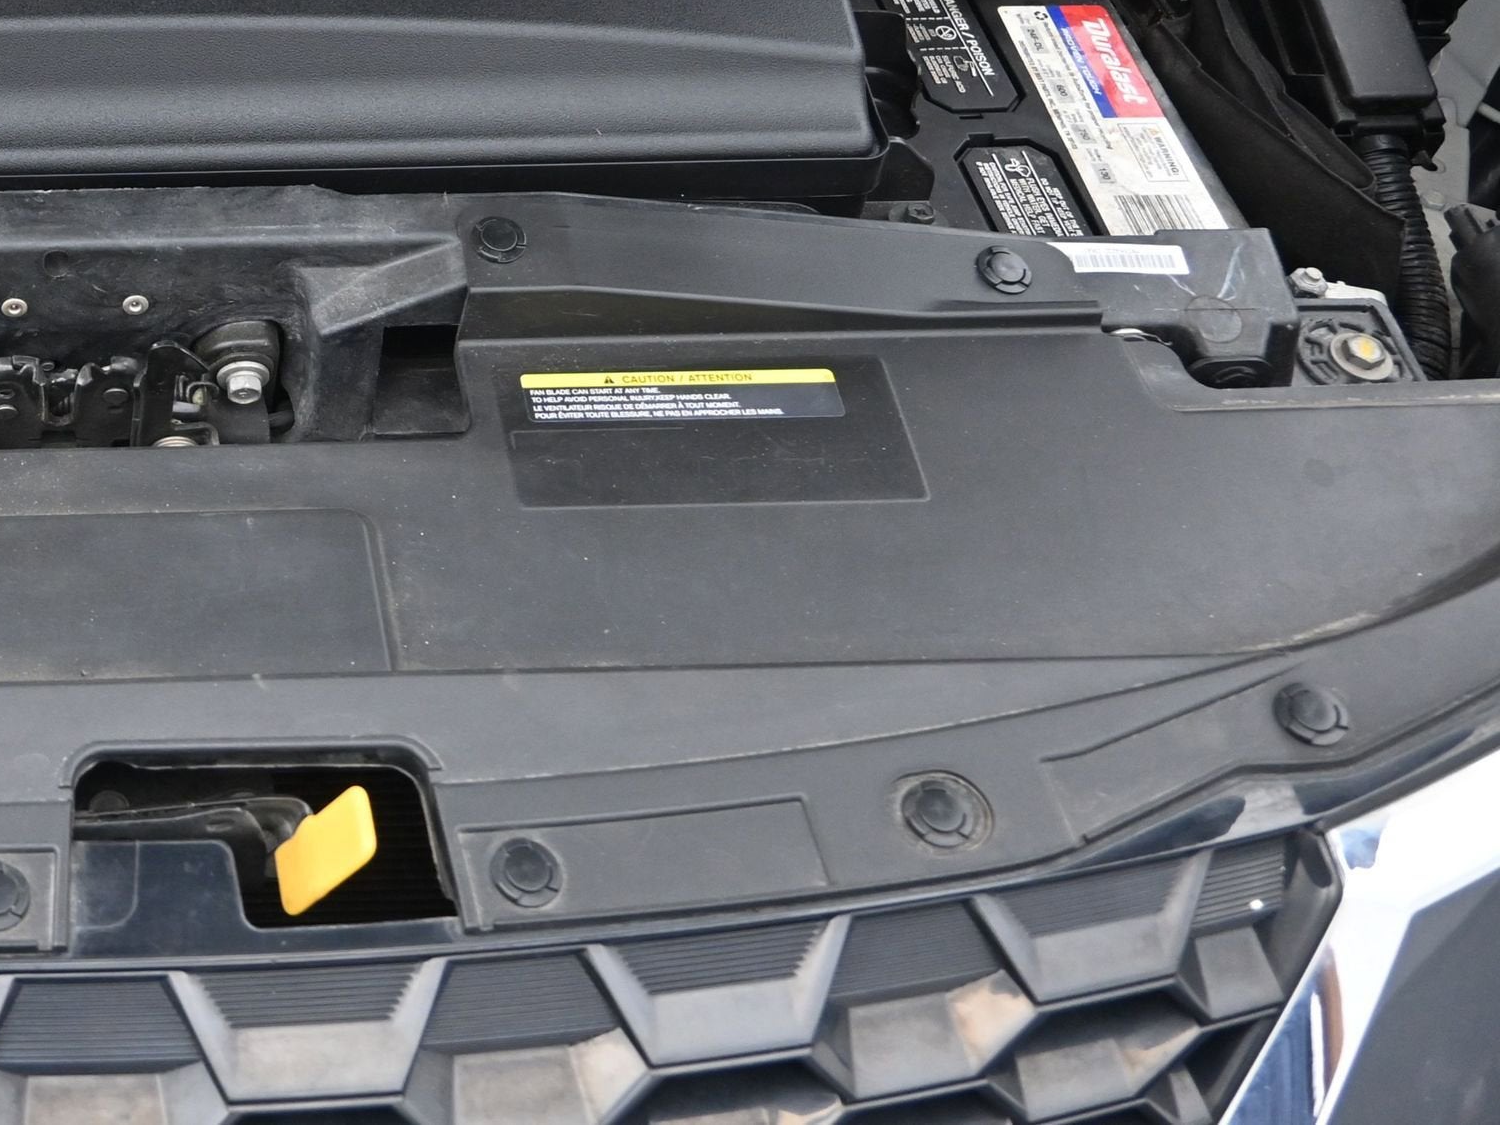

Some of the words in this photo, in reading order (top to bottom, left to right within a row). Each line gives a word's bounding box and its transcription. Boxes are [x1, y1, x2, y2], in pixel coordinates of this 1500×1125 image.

[965, 38, 995, 76] POISON
[1059, 28, 1086, 62] PROVEN
[1079, 65, 1103, 95] TOUGH
[1079, 18, 1149, 105] Duralast
[1153, 136, 1181, 175] WARNING:
[1008, 178, 1028, 202] MEDICAL
[1022, 203, 1036, 219] HELP
[1017, 178, 1031, 192] WITH
[1025, 177, 1042, 196] FLUSH
[1036, 196, 1050, 211] EYES
[1044, 212, 1064, 236] IMMEDIA
[622, 375, 675, 384] CAUTION
[688, 373, 753, 383] ATTENTION
